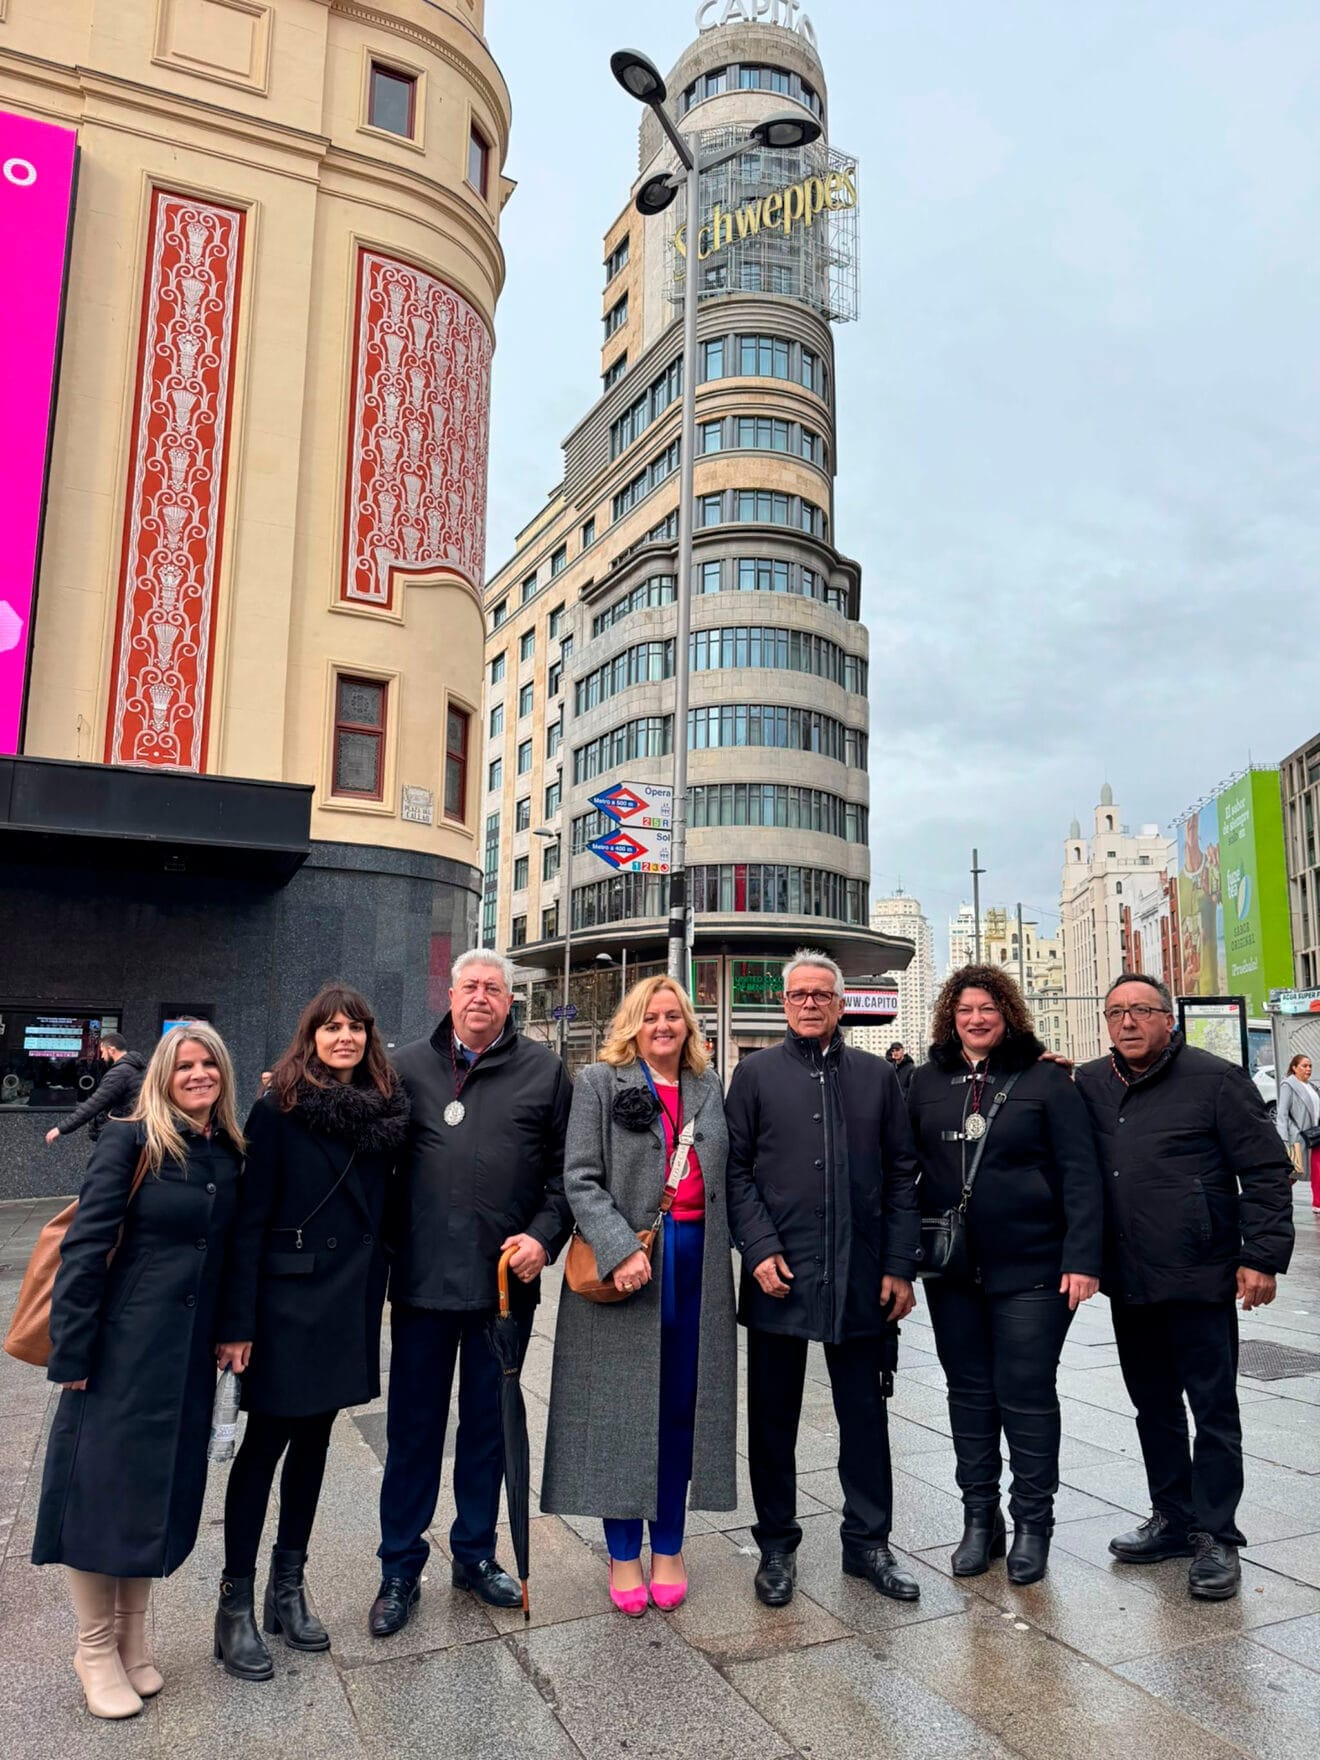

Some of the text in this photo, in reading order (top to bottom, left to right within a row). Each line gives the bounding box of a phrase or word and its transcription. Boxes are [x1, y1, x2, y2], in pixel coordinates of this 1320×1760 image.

[645, 784, 671, 797] Ópera
[593, 797, 610, 805] Metro
[656, 832, 671, 841] Sol
